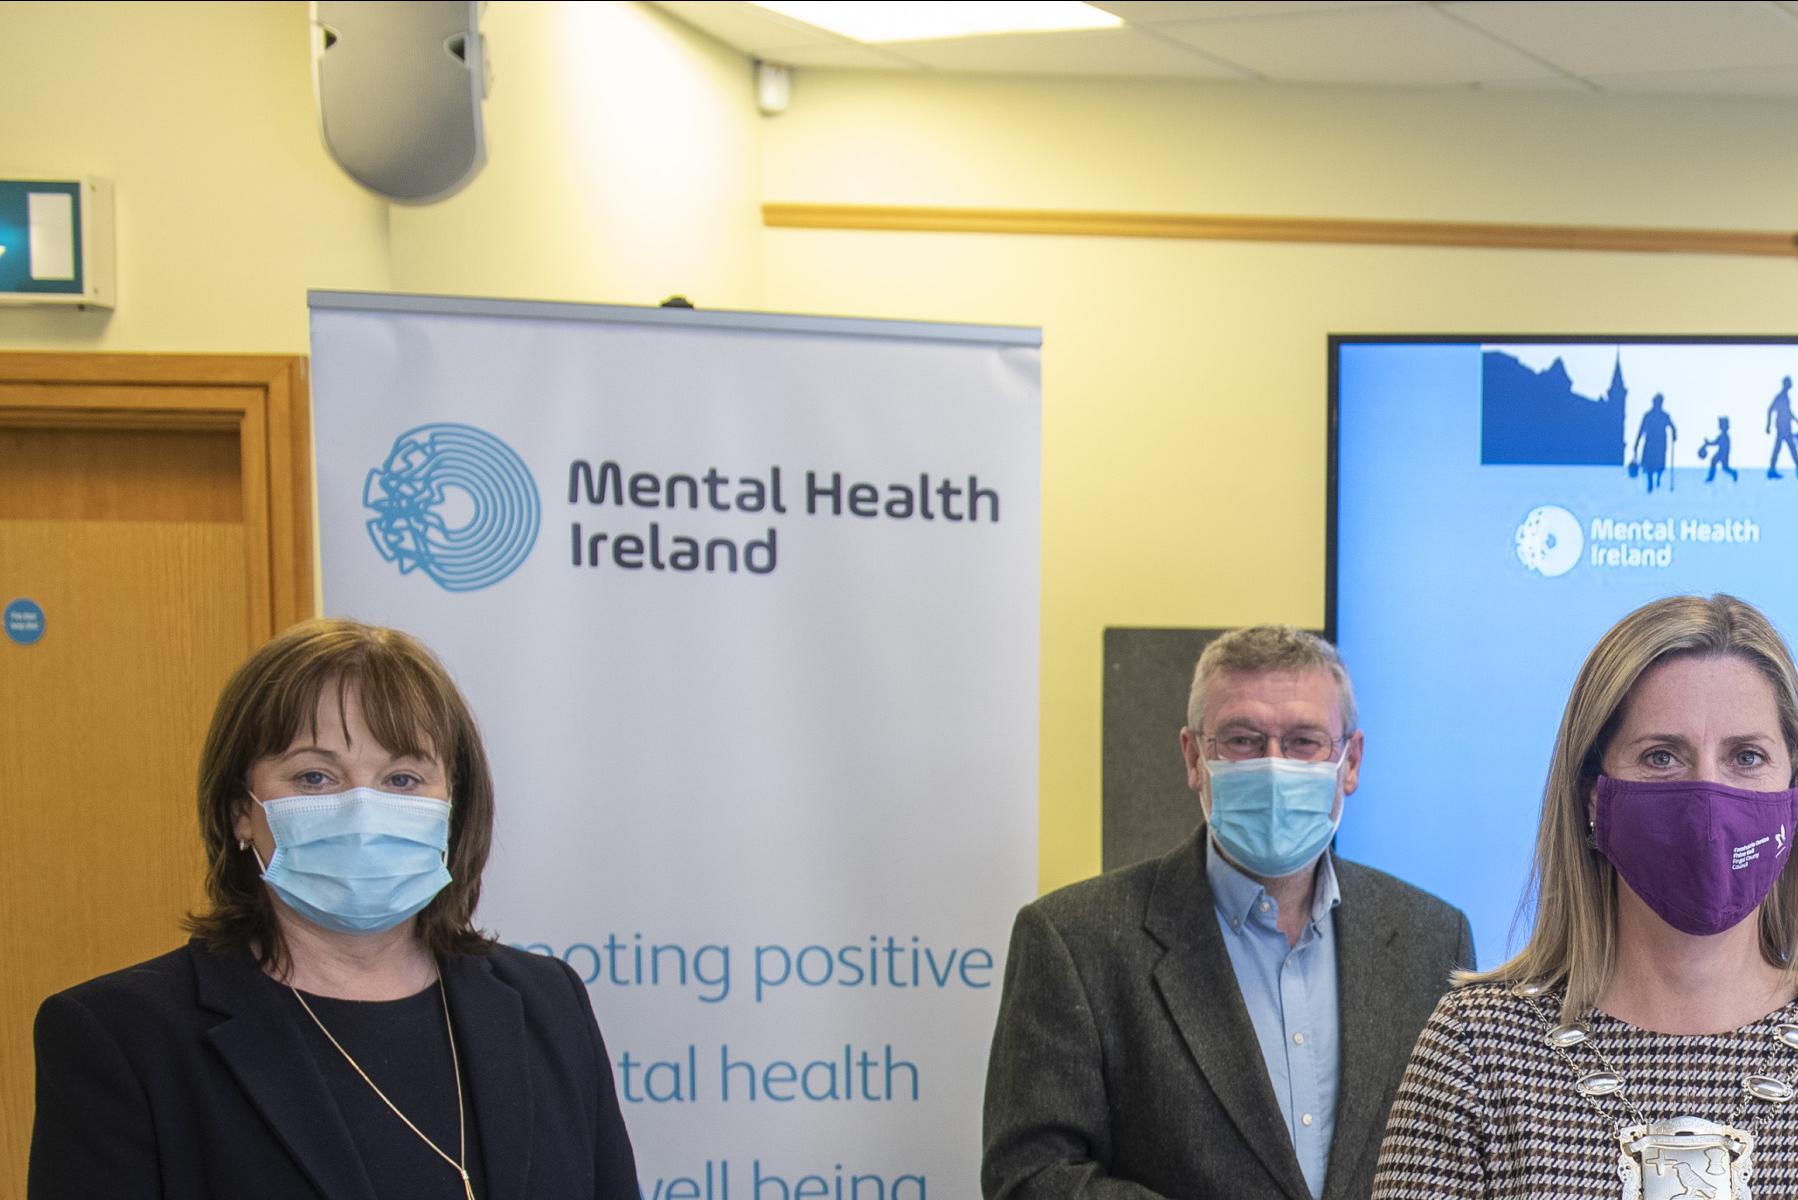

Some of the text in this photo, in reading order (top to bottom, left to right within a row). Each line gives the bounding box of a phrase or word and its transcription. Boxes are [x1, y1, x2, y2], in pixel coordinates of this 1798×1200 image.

[568, 459, 1000, 523] Mental Health
[570, 522, 778, 574] Ireland
[1590, 518, 1760, 543] Mental Health
[1591, 543, 1672, 567] Ireland
[509, 932, 994, 1003] oting positive
[721, 1043, 920, 1103] health
